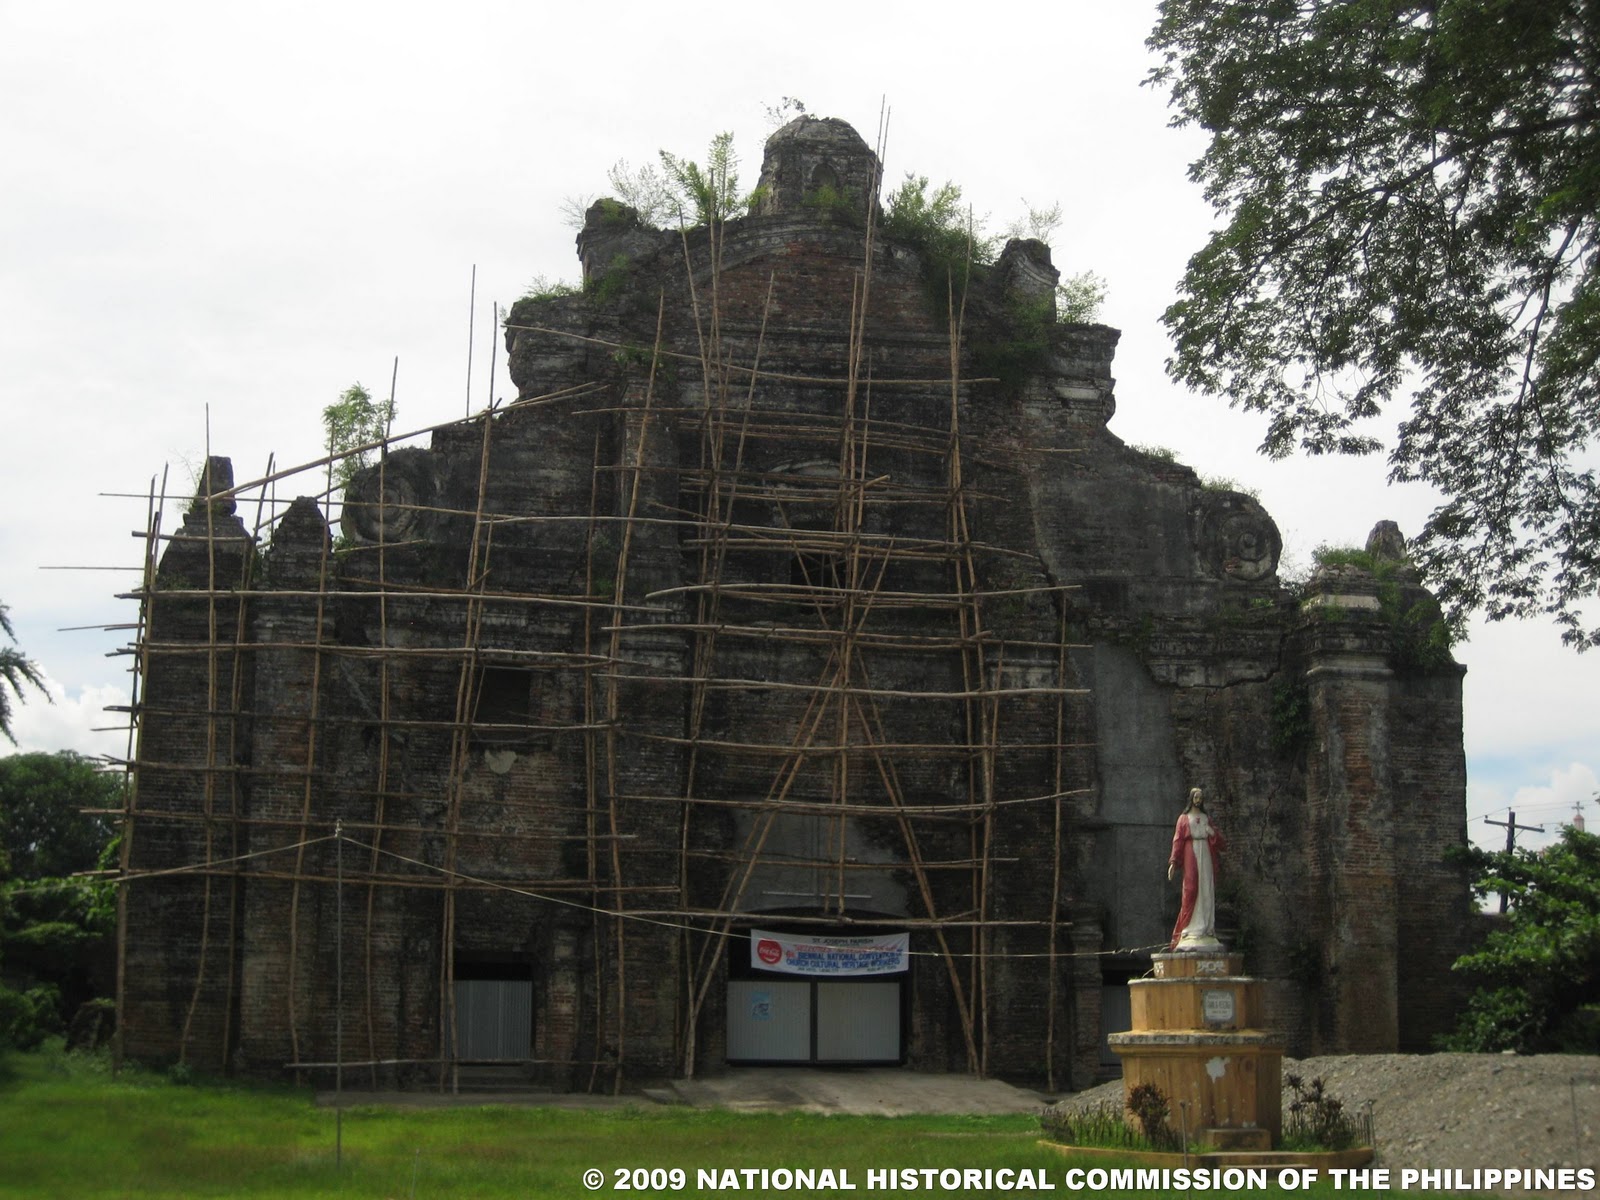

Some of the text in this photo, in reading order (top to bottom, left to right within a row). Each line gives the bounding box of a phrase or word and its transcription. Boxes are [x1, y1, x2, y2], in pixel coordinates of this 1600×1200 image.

[827, 952, 857, 961] NATIONAL
[786, 958, 810, 967] CHURCH
[811, 960, 840, 969] CULTURAL
[842, 960, 869, 969] HERITAGE
[870, 957, 900, 967] WORKERS
